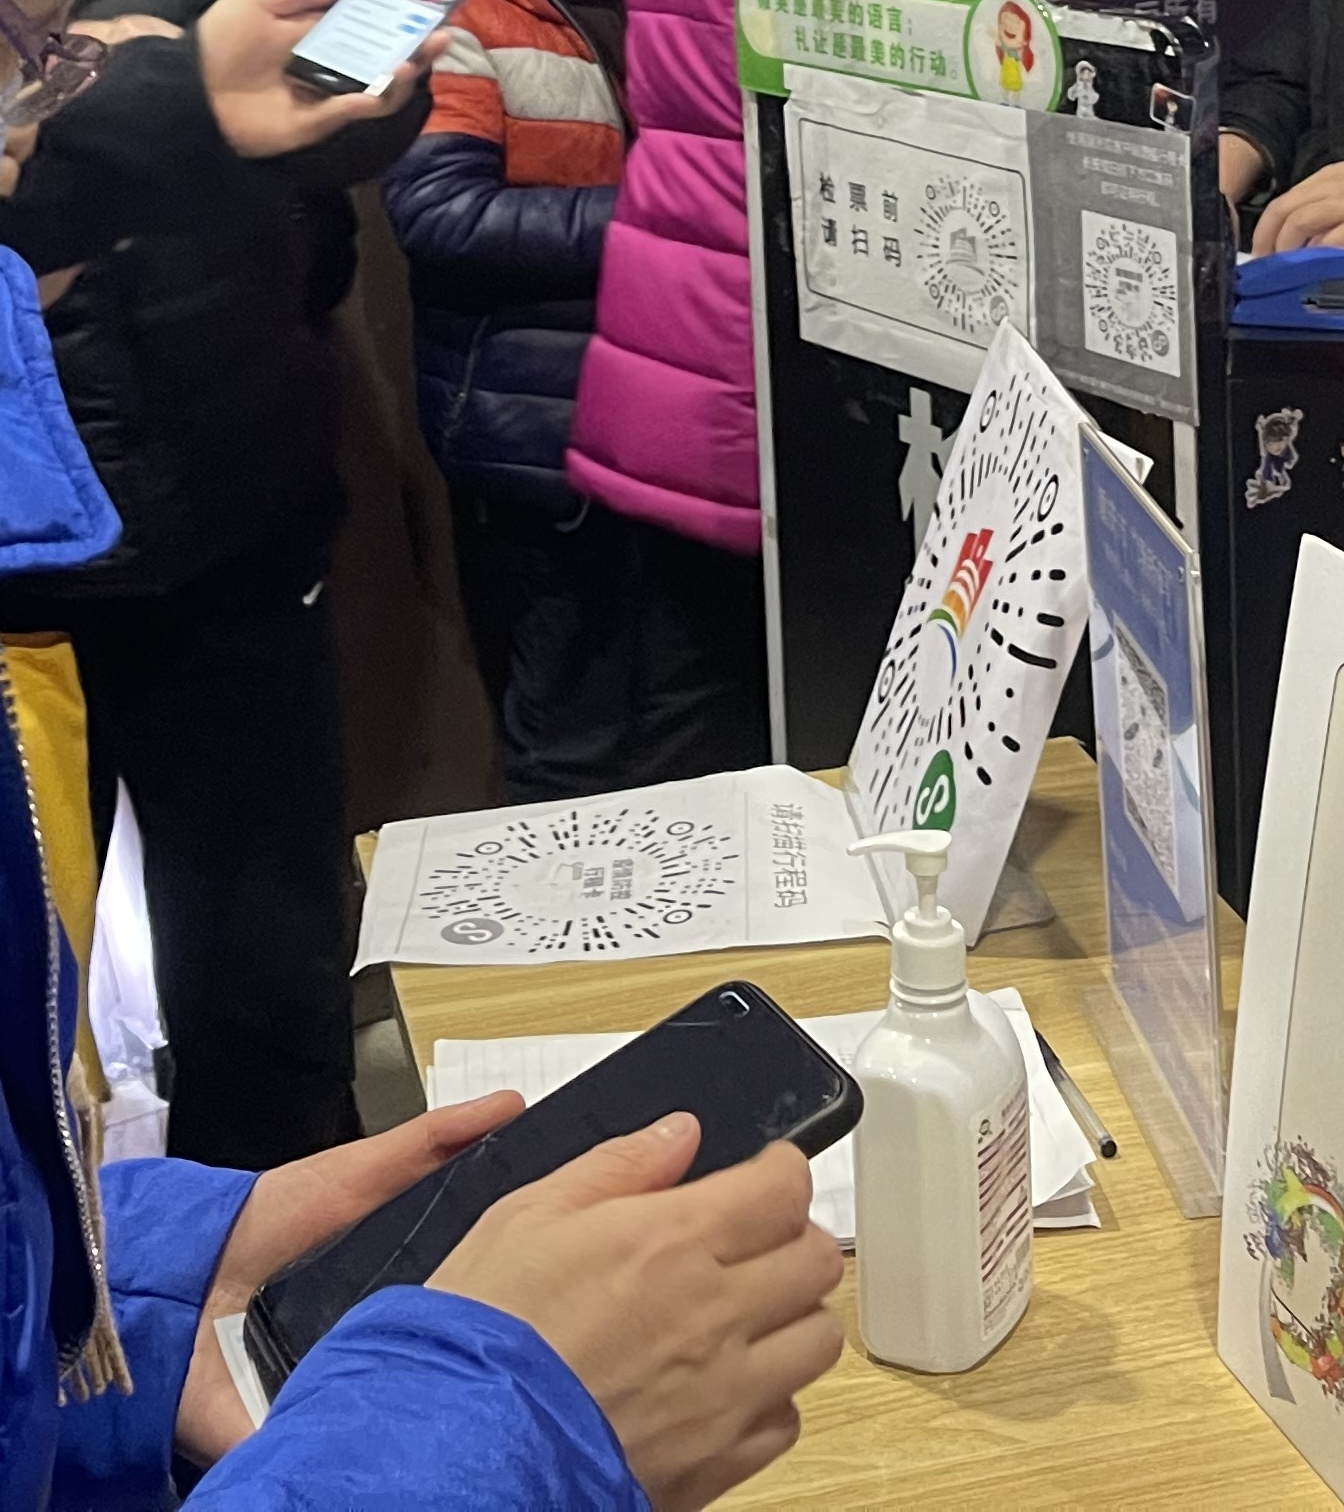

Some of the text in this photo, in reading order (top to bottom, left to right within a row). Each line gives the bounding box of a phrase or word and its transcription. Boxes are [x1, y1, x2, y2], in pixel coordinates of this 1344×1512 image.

[819, 171, 898, 222] 检票前
[771, 803, 808, 909] 请扫描行程码
